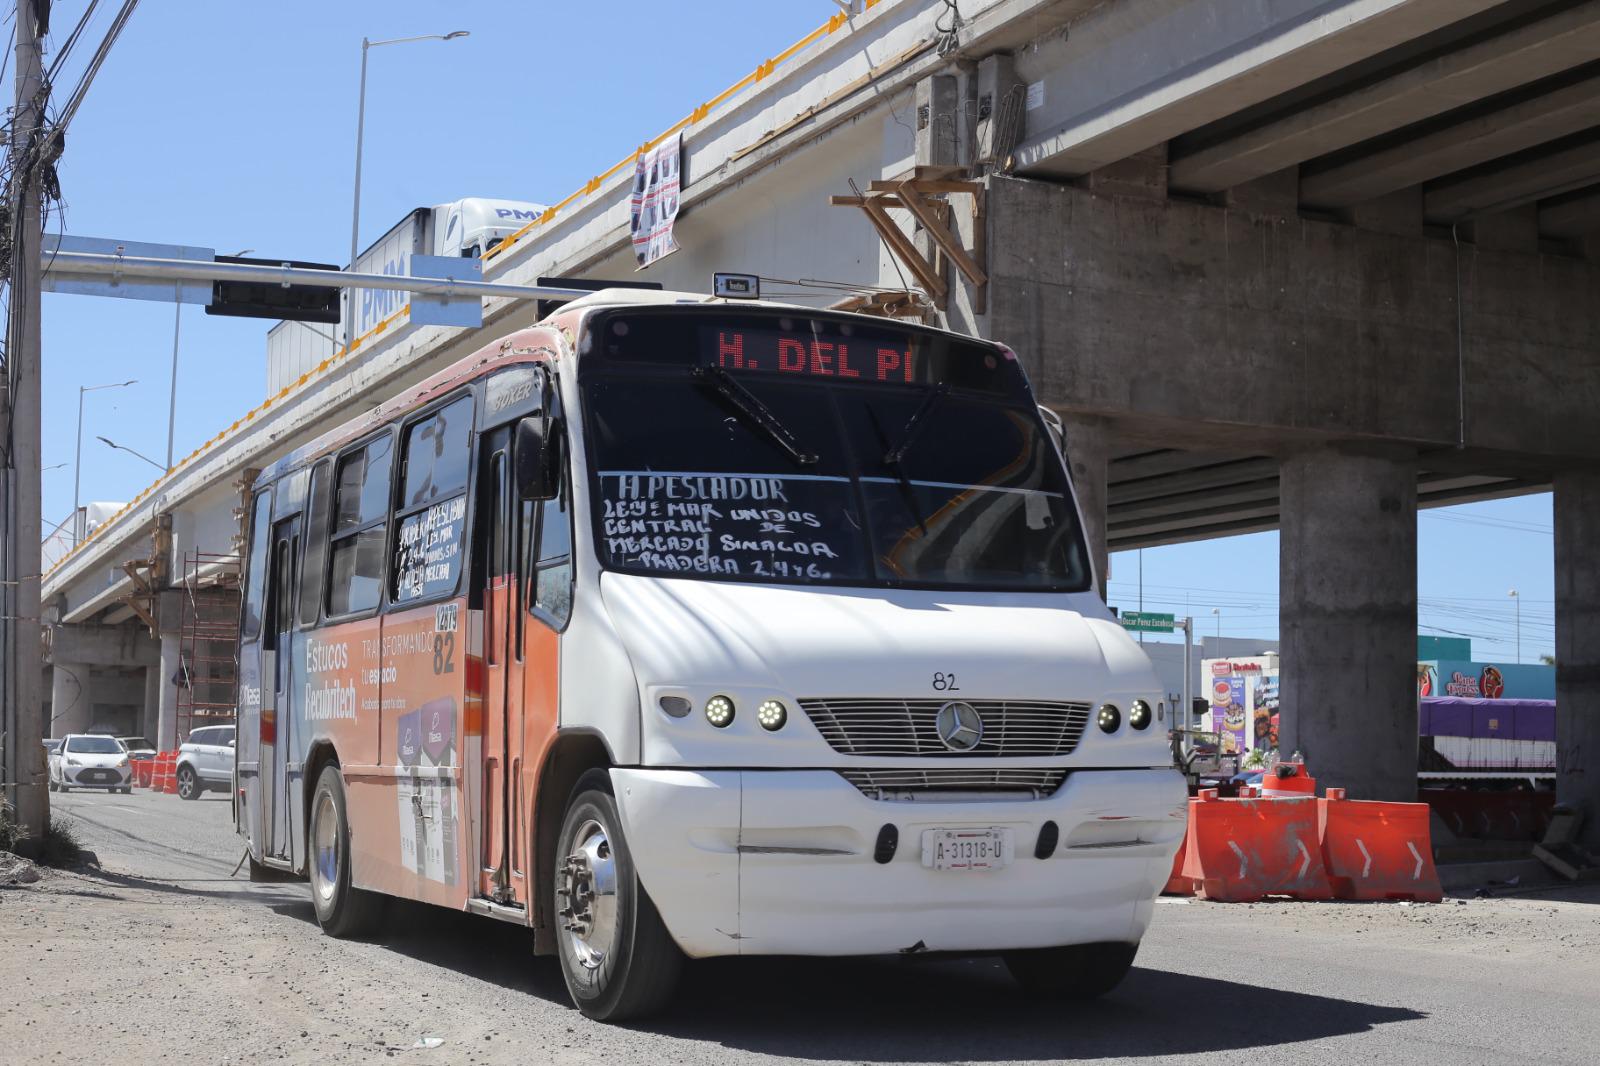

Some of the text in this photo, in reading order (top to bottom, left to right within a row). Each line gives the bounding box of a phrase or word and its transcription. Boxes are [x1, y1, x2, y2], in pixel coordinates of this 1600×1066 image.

[496, 208, 541, 221] PM
[719, 332, 758, 369] H.
[778, 338, 860, 377] DEL
[604, 519, 795, 536] CENTRAL DE
[667, 503, 723, 520] MAR
[730, 508, 822, 528] UNIDOS
[608, 534, 840, 559] MERCADO SINALOA
[638, 550, 740, 575] PRADERA
[306, 638, 348, 673] Estucos
[362, 631, 433, 659] TRANSFORMANDO
[433, 632, 455, 676] 82
[932, 672, 960, 691] 82
[937, 841, 1002, 860] A-31318-U
